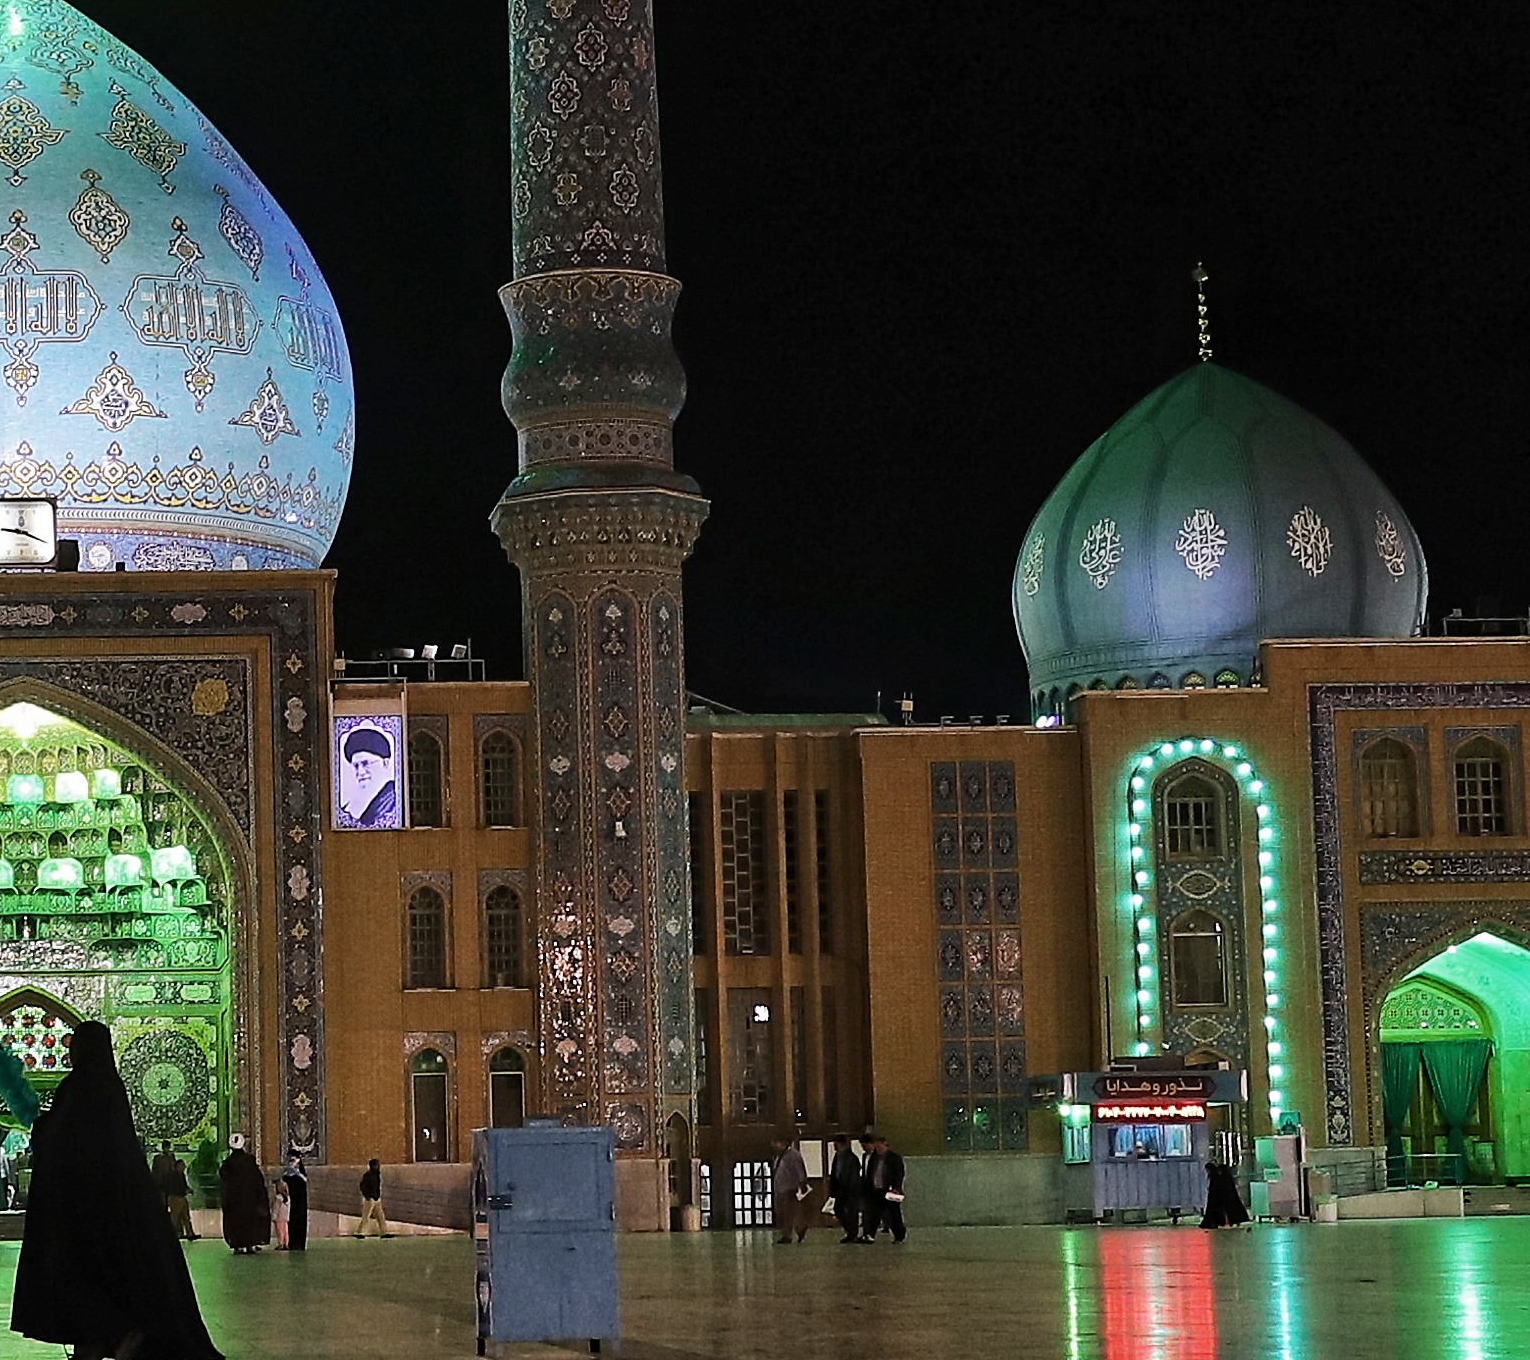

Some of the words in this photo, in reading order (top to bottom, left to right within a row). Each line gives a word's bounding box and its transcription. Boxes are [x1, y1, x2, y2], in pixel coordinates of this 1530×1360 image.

[1106, 1078, 1151, 1096] هدایا
[1152, 1082, 1161, 1096] و
[1161, 1078, 1203, 1096] نذور
